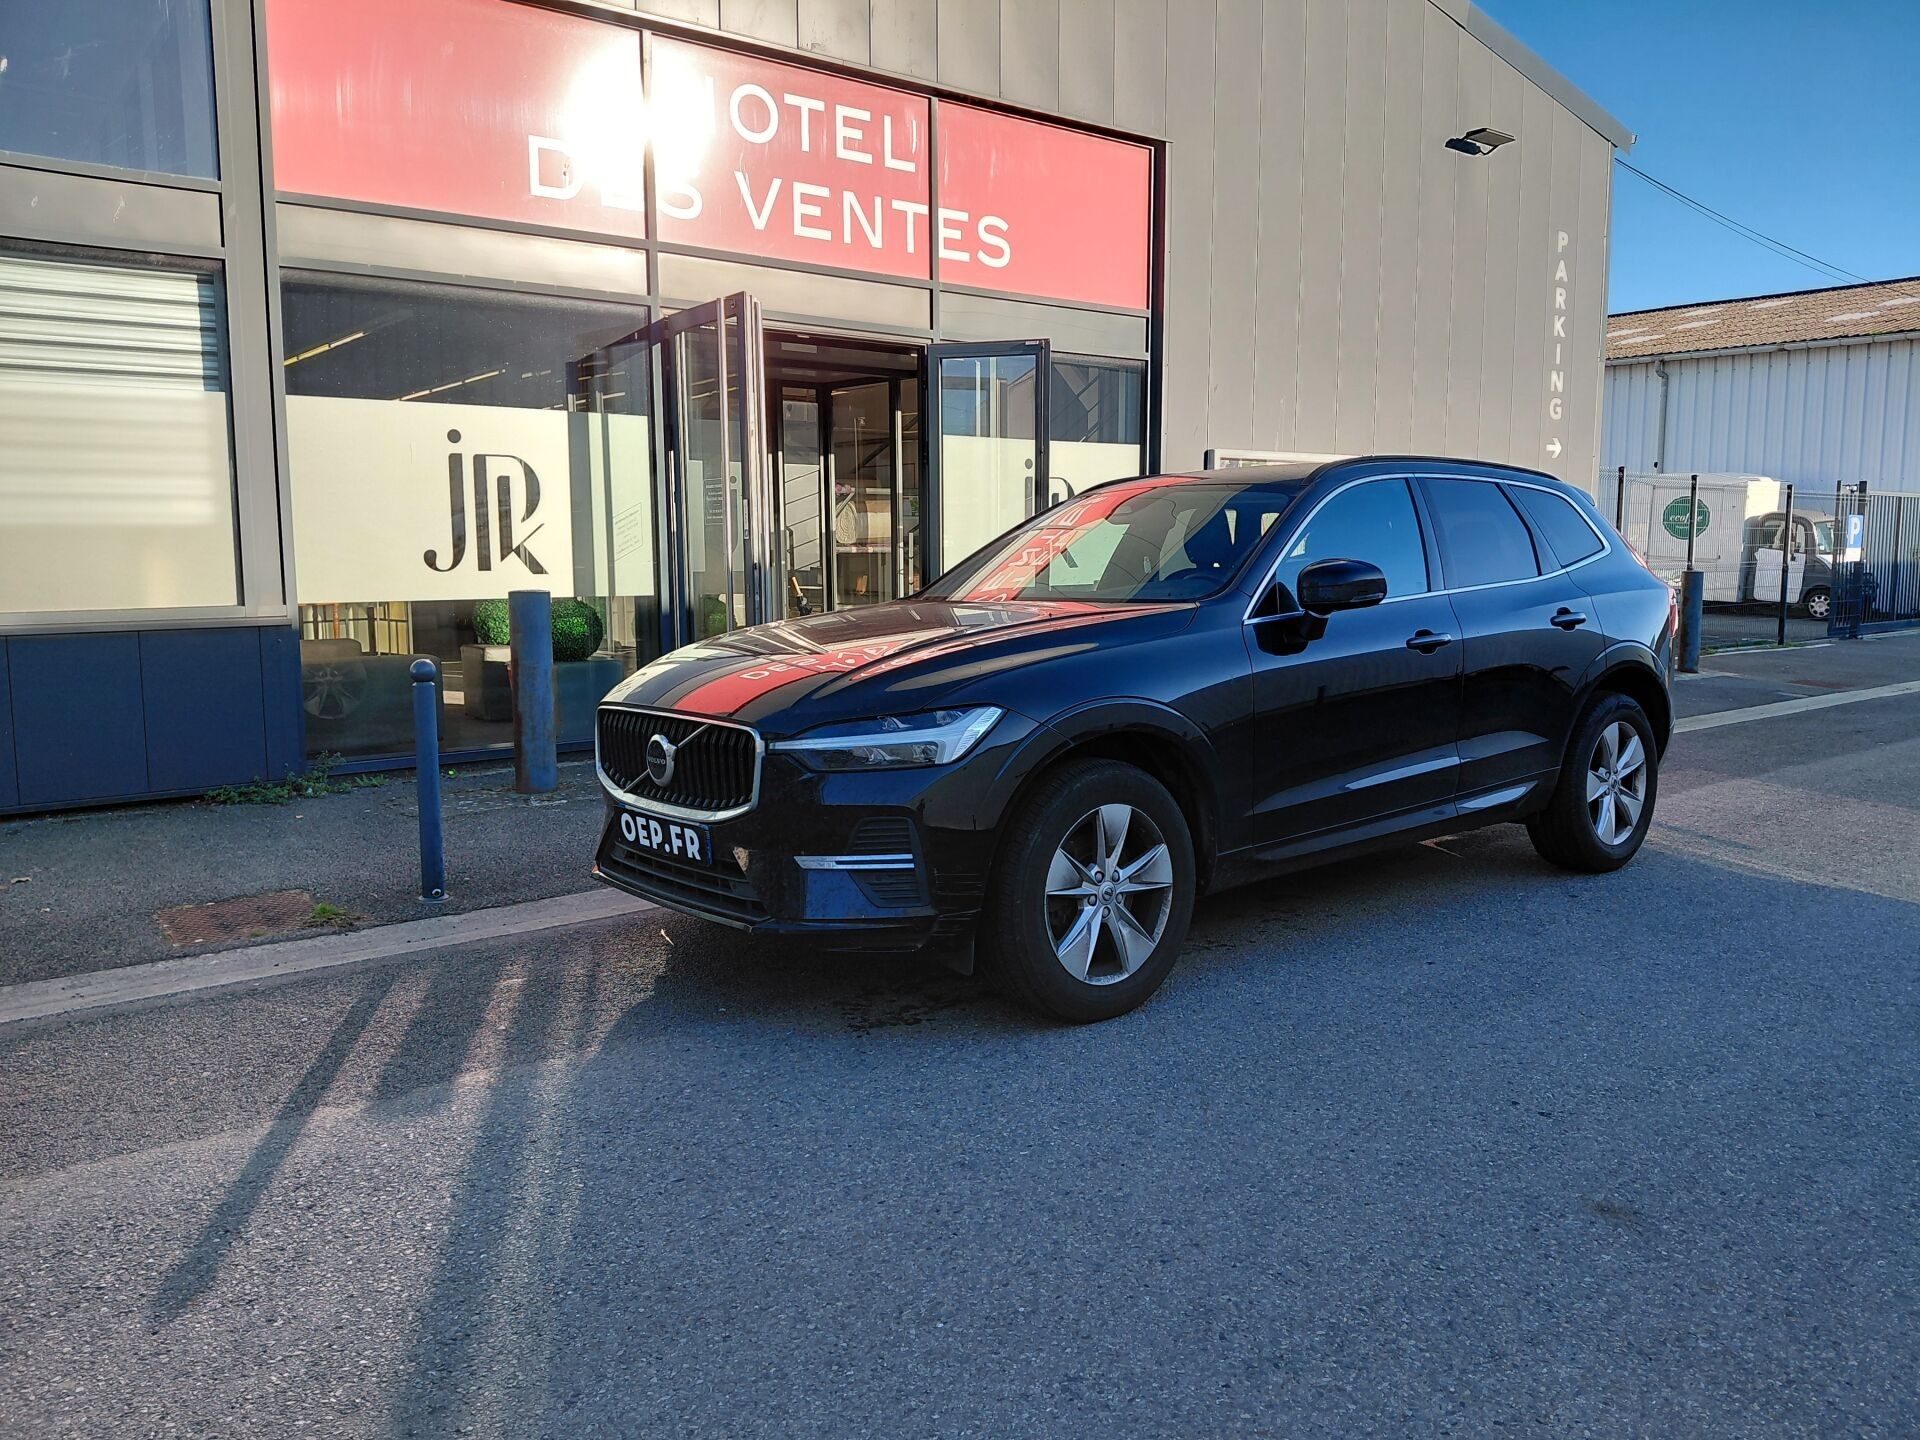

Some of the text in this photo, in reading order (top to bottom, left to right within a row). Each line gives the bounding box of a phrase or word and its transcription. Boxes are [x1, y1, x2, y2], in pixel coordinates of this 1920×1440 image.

[734, 170, 1012, 269] VENTES
[1549, 230, 1569, 421] PARKING
[620, 812, 702, 861] OEP.FR
